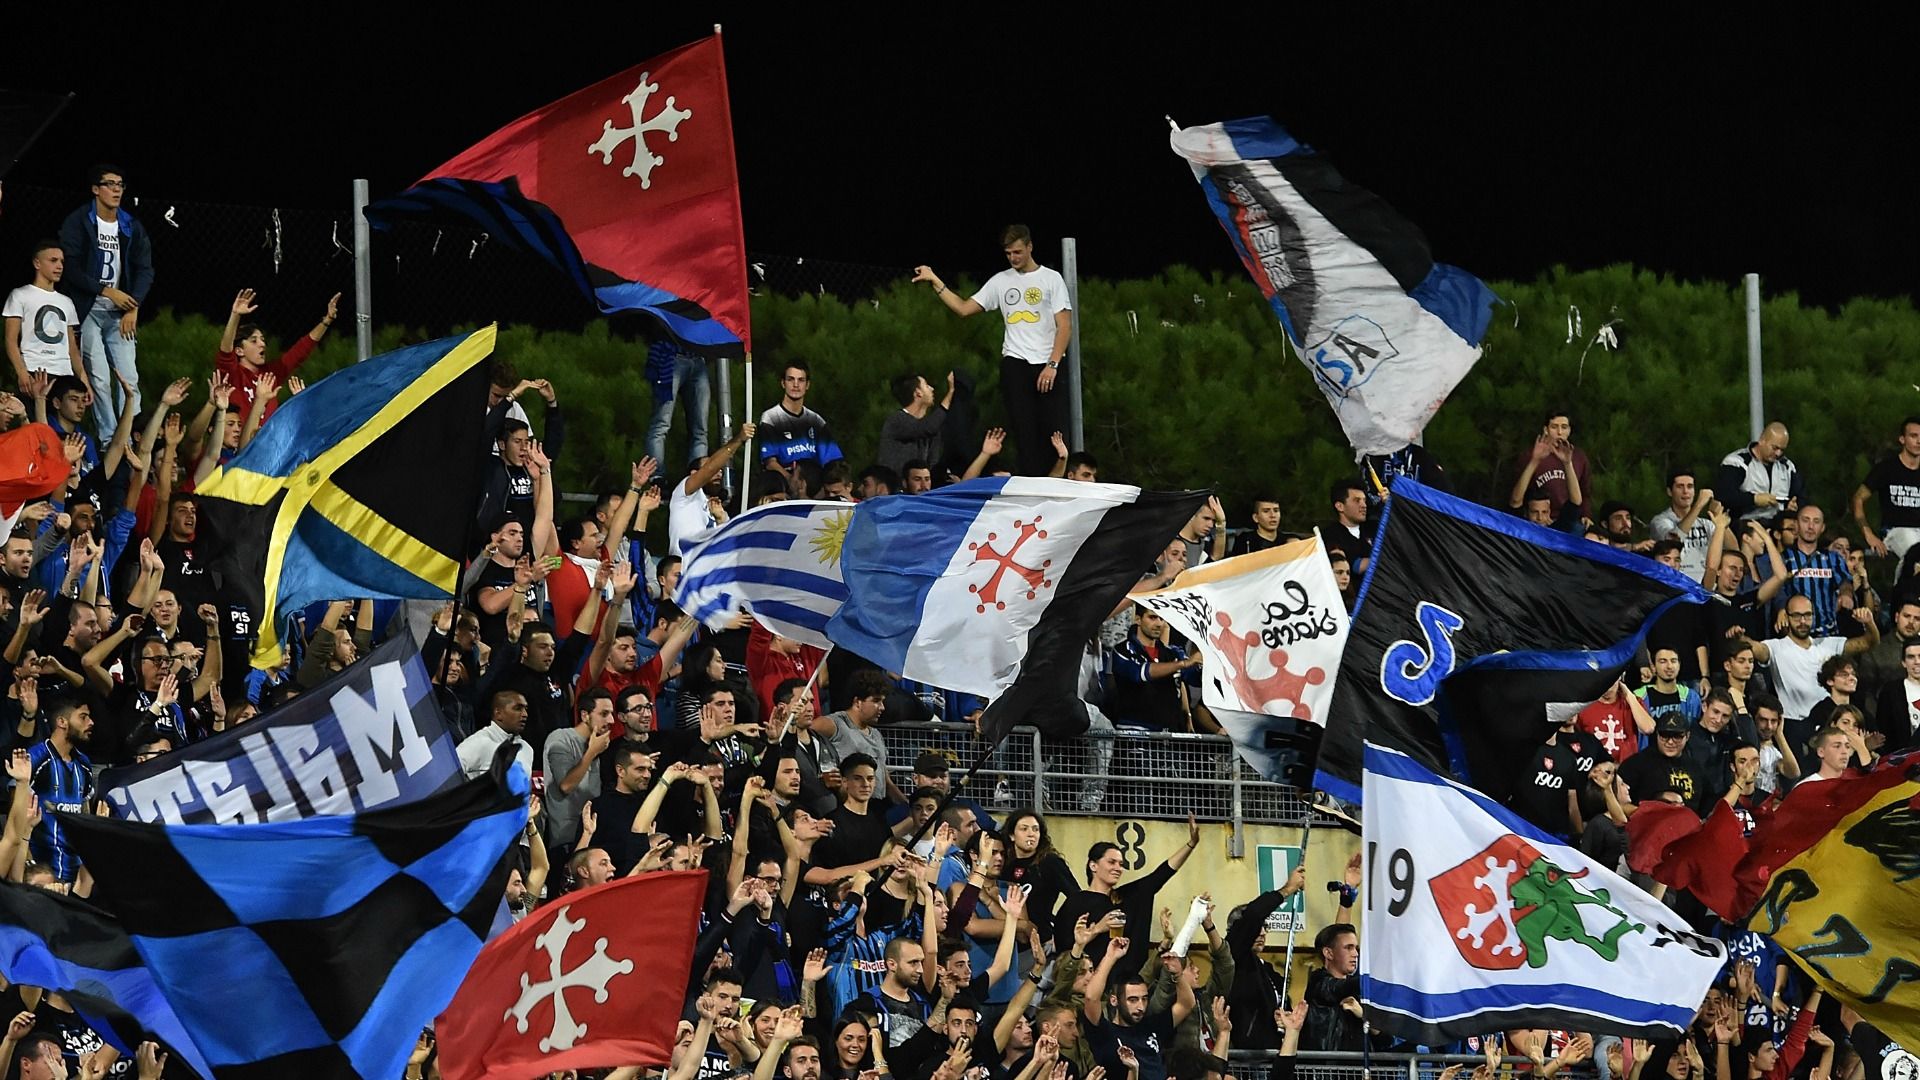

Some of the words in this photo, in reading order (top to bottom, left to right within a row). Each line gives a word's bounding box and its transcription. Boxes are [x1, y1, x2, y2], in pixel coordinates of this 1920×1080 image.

[34, 304, 66, 344] C
[1535, 469, 1566, 488] ATHLETI
[231, 610, 251, 623] PIS
[235, 623, 249, 634] SI
[1116, 821, 1147, 871] 8
[1265, 922, 1305, 930] MERGEZA
